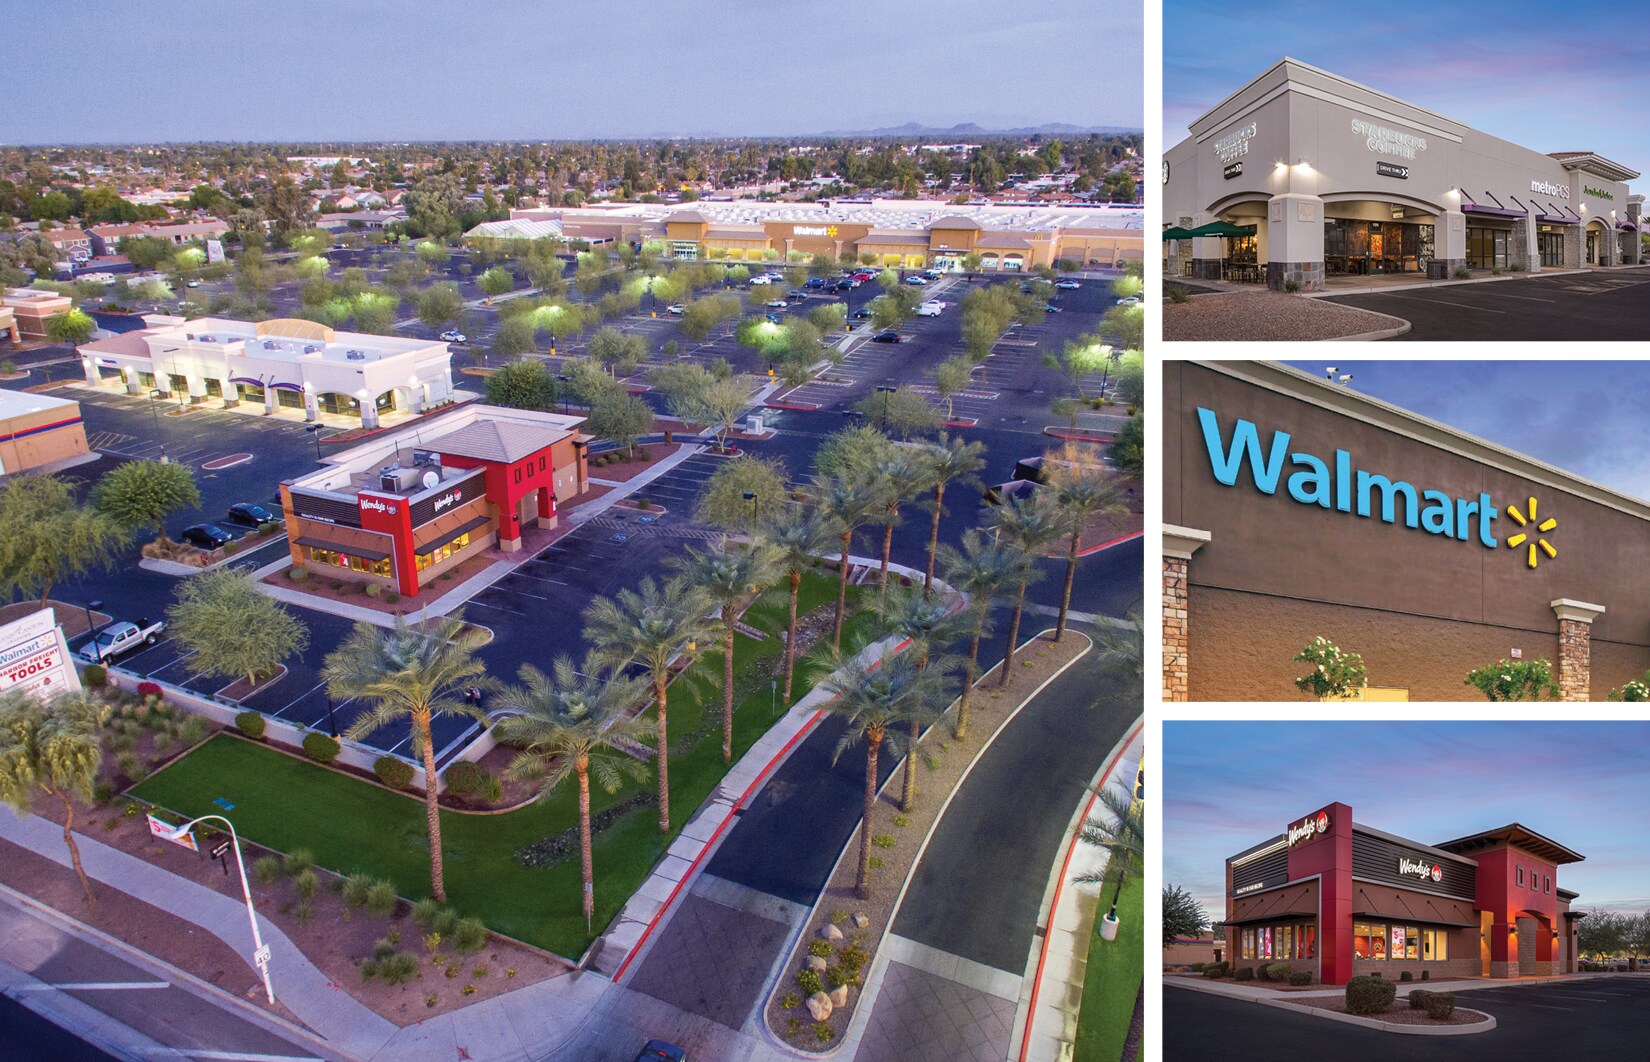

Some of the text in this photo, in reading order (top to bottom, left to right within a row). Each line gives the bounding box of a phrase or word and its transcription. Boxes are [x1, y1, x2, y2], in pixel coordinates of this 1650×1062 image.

[1530, 179, 1570, 199] metroPCS
[793, 225, 828, 236] Walmart
[1196, 406, 1498, 548] Walmart
[360, 498, 386, 513] Wendy's
[433, 493, 454, 513] Wendy's
[29, 648, 58, 665] FREIGHT
[9, 657, 53, 682] TOOLS
[1288, 818, 1316, 847] Wendy's
[1399, 858, 1431, 879] Wendy's
[257, 952, 270, 965] 40
